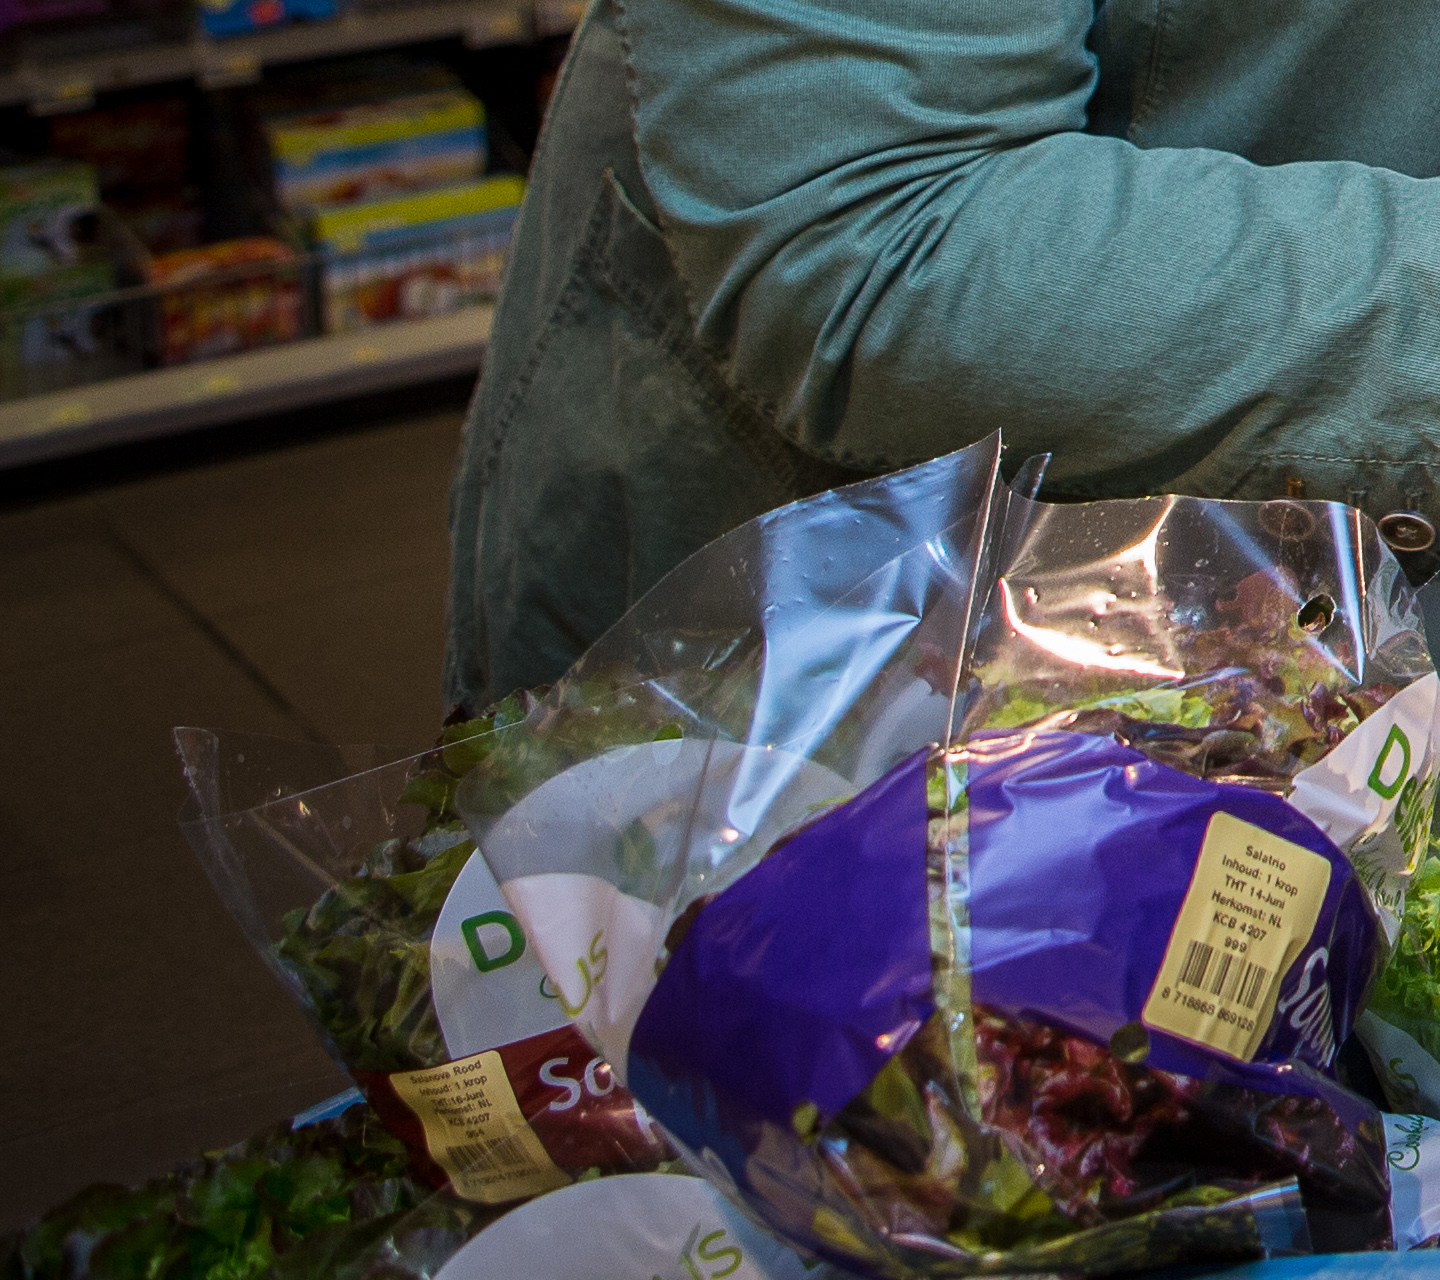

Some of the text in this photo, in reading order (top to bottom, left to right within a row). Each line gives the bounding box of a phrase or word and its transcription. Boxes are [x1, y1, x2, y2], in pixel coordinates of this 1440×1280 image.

[1245, 845, 1287, 872] Salatrio
[1222, 854, 1299, 897] Inhoud: 1 krop
[1225, 874, 1286, 910] THT 14-Juni
[1211, 890, 1282, 929] Herkomst: NL
[1213, 910, 1268, 942] KCB 4207
[1161, 986, 1171, 1000] 8
[452, 1059, 483, 1078] Rood
[455, 1080, 462, 1091] 1
[463, 1074, 489, 1090] krop
[478, 1097, 493, 1109] NL
